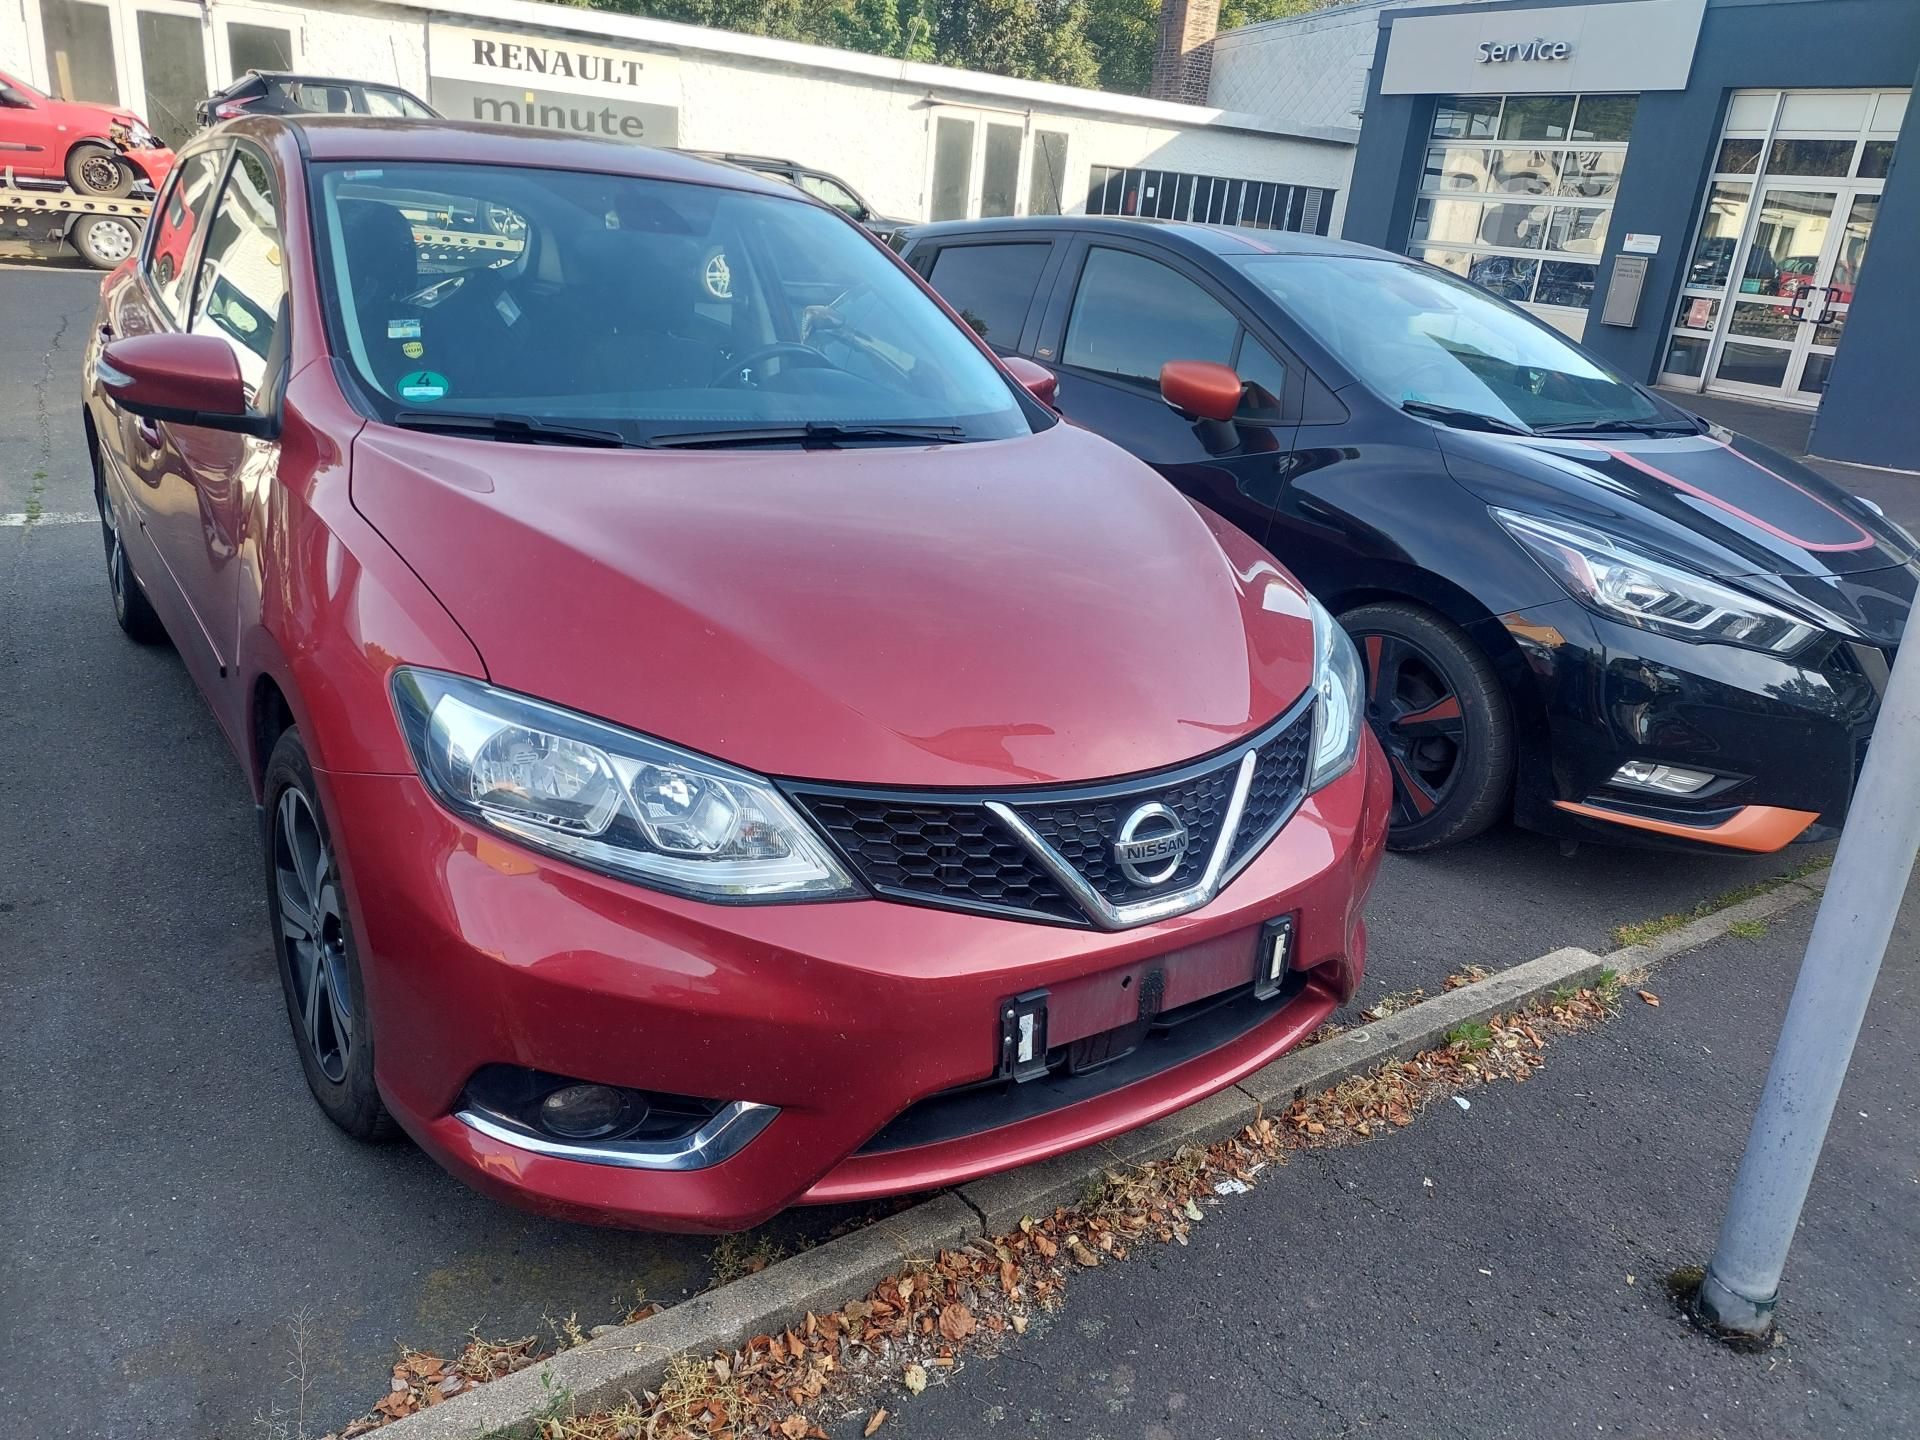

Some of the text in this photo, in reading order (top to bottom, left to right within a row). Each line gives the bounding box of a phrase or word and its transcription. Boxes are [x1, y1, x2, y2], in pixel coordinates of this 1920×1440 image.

[472, 39, 644, 86] RENAULT
[1476, 37, 1570, 63] Service
[473, 92, 644, 138] minute
[416, 372, 431, 386] 4
[1127, 836, 1186, 859] NISSAN
